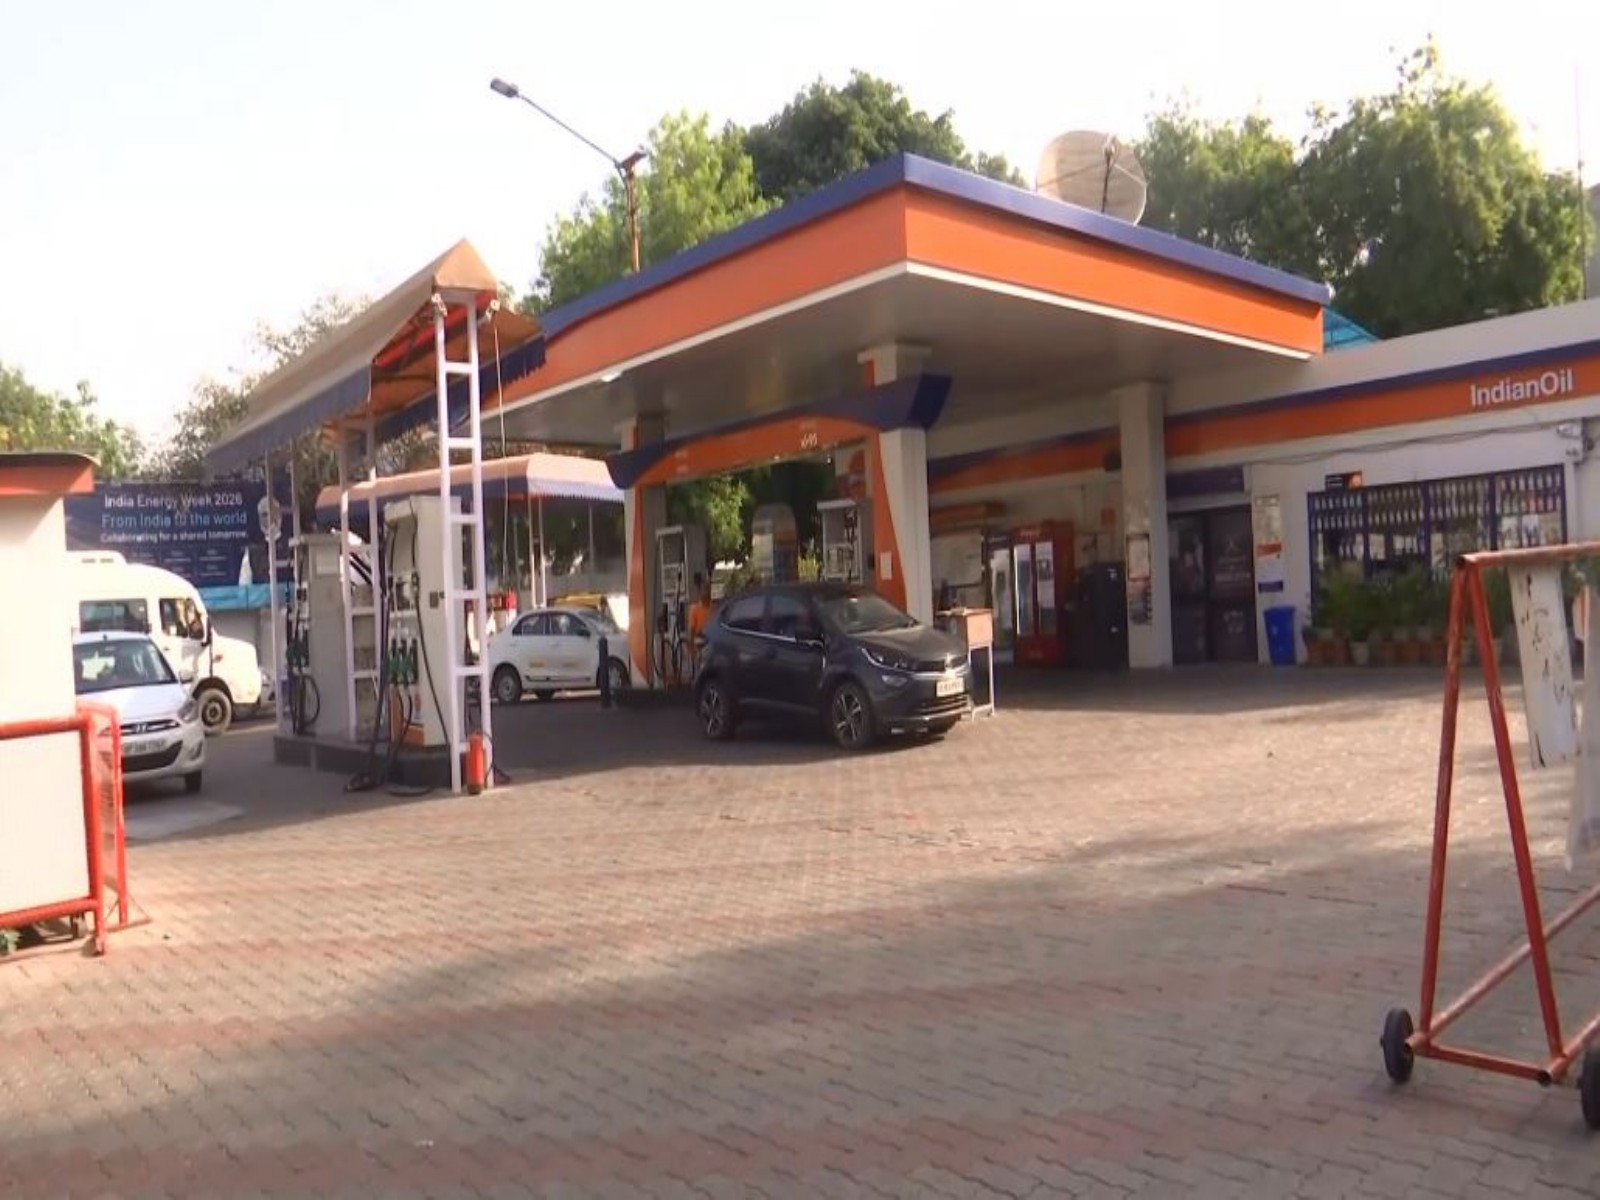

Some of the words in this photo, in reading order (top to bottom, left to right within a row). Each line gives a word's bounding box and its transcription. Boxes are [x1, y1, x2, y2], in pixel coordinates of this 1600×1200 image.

[1471, 368, 1573, 407] IndianOil
[104, 494, 134, 508] India
[137, 494, 177, 511] Energy
[181, 493, 212, 508] Week
[101, 513, 137, 528] From
[140, 512, 171, 528] India
[174, 513, 188, 527] to
[190, 511, 210, 527] the
[213, 511, 248, 525] world
[179, 530, 206, 541] shared
